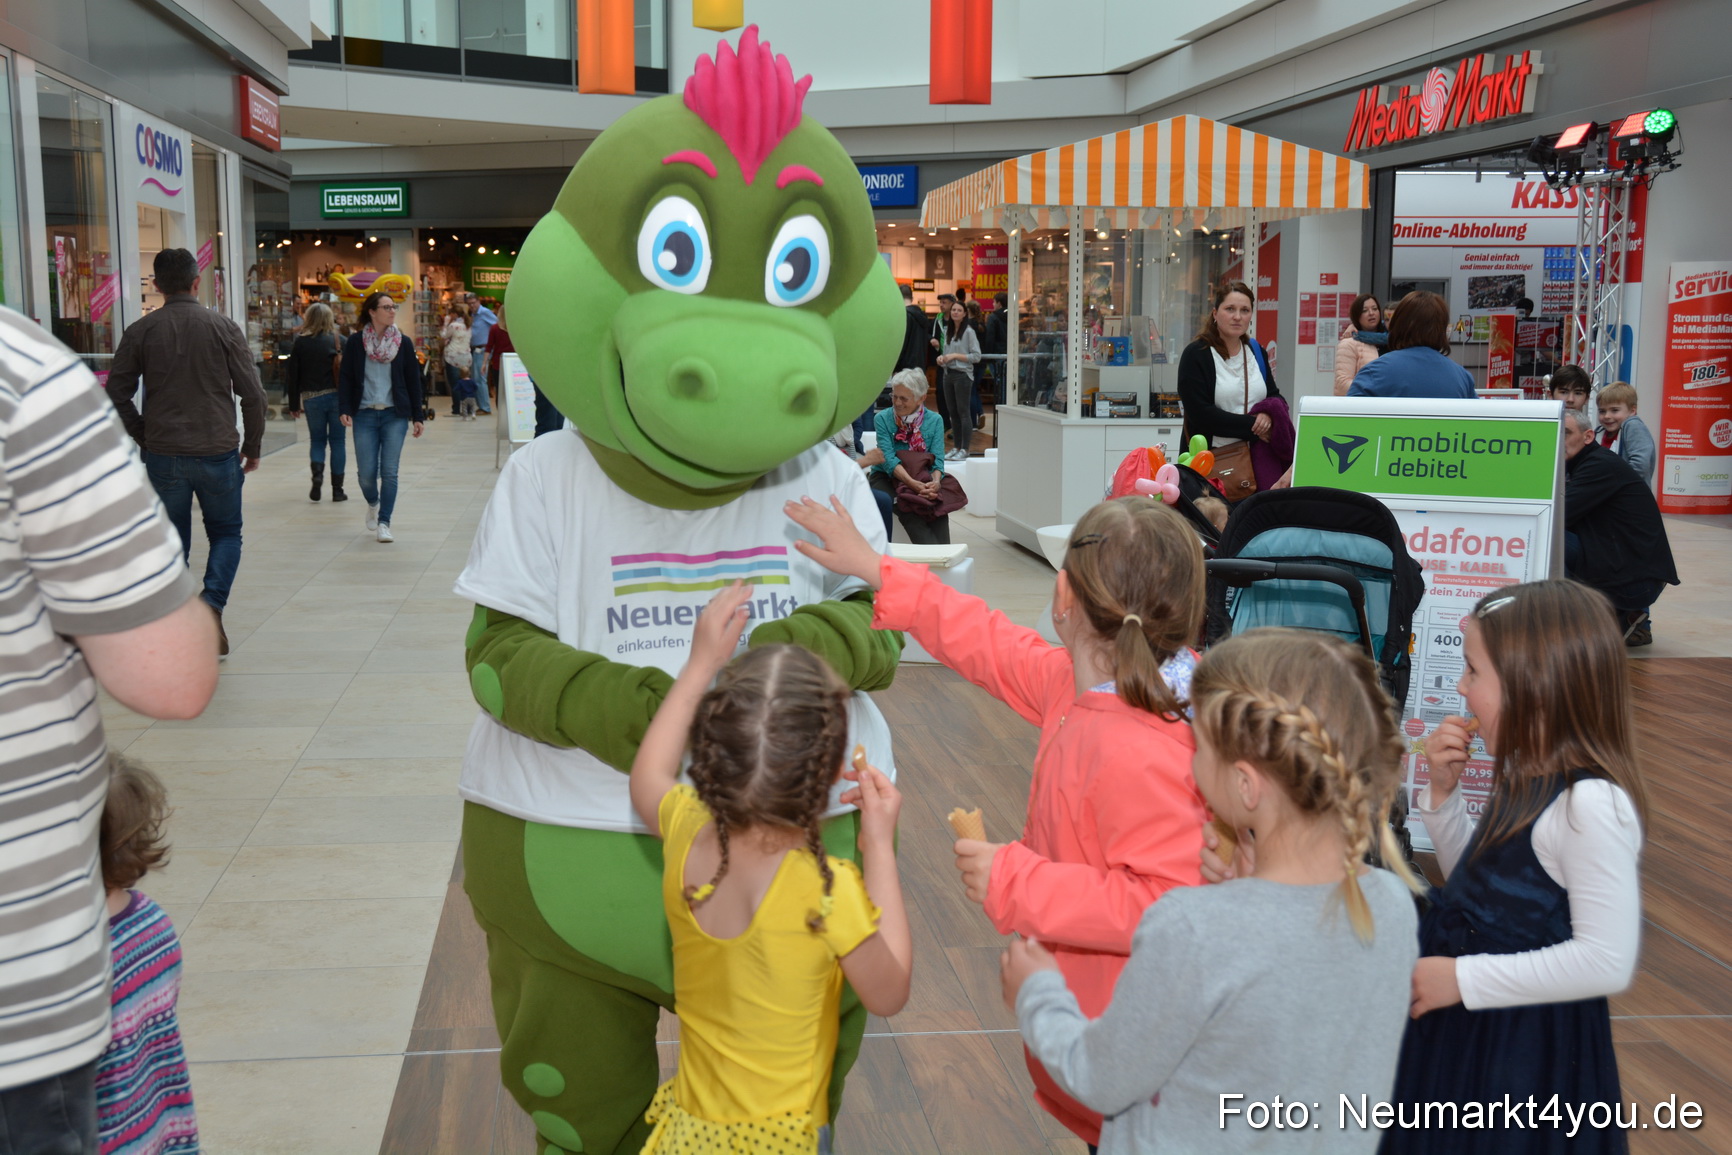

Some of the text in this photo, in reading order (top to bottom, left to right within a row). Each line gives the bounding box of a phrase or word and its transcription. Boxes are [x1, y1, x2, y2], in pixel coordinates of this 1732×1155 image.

[136, 123, 183, 177] COSMO
[862, 173, 905, 190] ONROE
[328, 193, 398, 206] LEBENSRAUM
[1393, 222, 1528, 241] Online-Abholung
[1464, 253, 1520, 262] Genial einfach
[1505, 263, 1534, 272] Richtige!
[475, 272, 512, 283] LEBENSR
[975, 274, 1008, 289] ALLES
[1684, 270, 1721, 282] MediaMarkt
[1673, 313, 1701, 322] Strom
[1702, 313, 1721, 322] und
[1672, 324, 1686, 333] bei
[1490, 367, 1511, 377] EUCH.
[1692, 365, 1725, 381] 180.-
[1715, 422, 1729, 431] WIR
[1391, 432, 1532, 456] mobilcom
[1388, 458, 1468, 479] debitel
[1401, 526, 1526, 558] dafone
[1419, 559, 1447, 571] USE
[1460, 561, 1507, 575] KABEL
[1429, 587, 1453, 596] dein
[617, 636, 685, 653] einkaufen
[1434, 634, 1462, 647] 400
